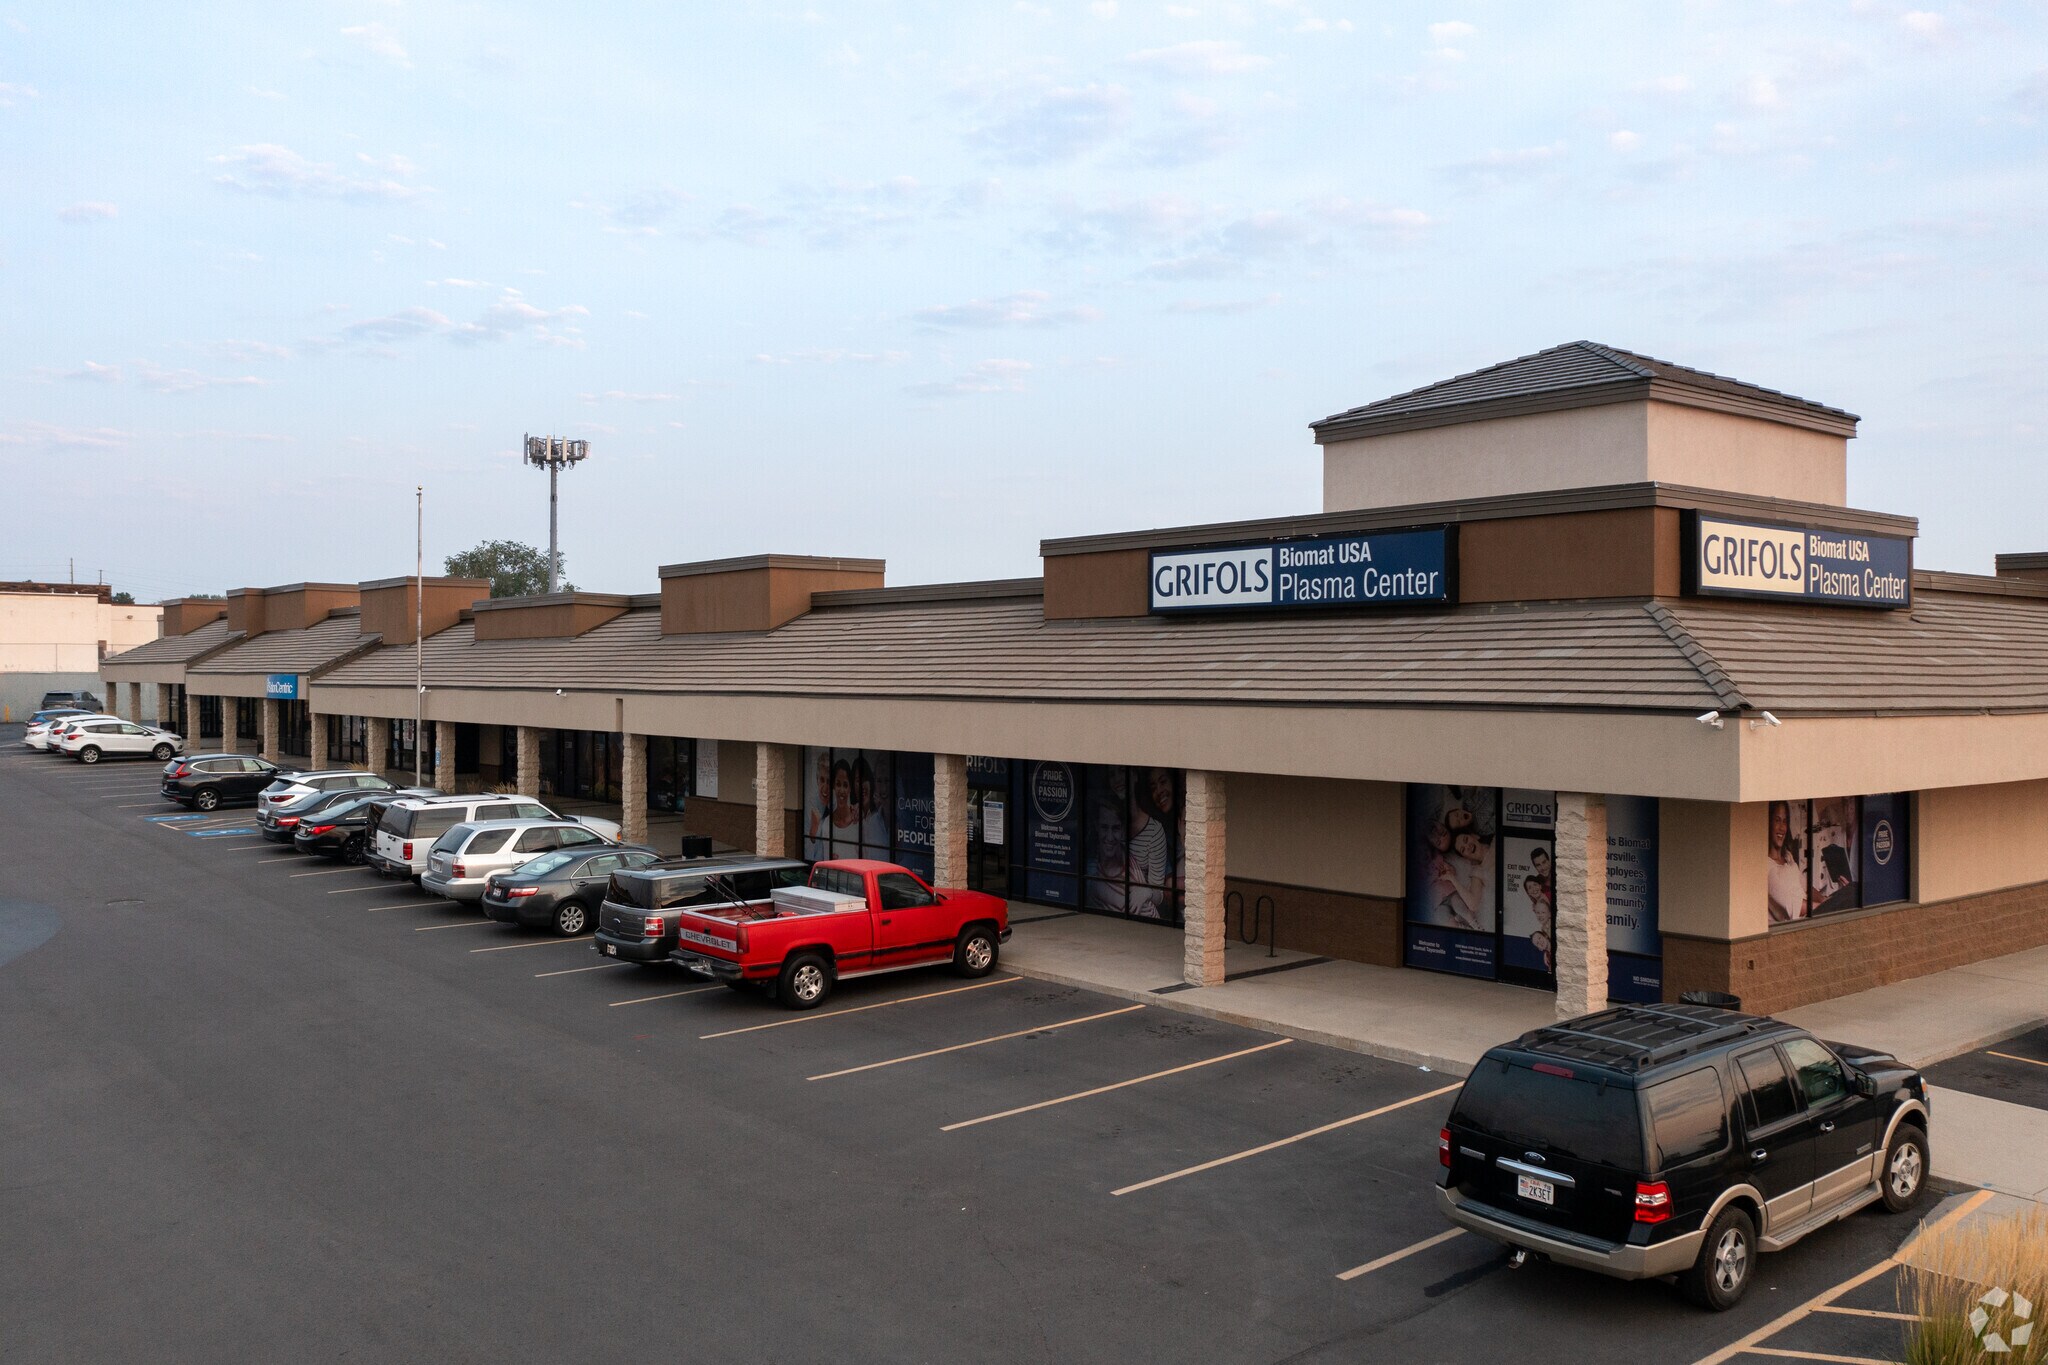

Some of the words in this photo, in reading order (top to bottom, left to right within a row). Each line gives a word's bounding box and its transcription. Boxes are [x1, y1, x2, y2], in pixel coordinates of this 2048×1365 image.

[1279, 544, 1335, 568] Biomat
[1338, 541, 1372, 564] USA
[1809, 535, 1847, 560] Biomat
[1849, 540, 1870, 562] USA
[1703, 533, 1802, 581] GRIFOLS
[1154, 558, 1269, 597] GRIFOLS
[1279, 572, 1356, 601] Plasma
[1363, 567, 1439, 598] Center
[1809, 563, 1860, 597] Plasma
[1864, 568, 1906, 600] Center
[1042, 769, 1063, 781] PRIDE
[1038, 786, 1068, 798] PASSION
[897, 797, 935, 813] CARING
[1506, 802, 1552, 815] GRIFOLS
[897, 829, 935, 847] PEOPLE
[1618, 836, 1650, 849] Biomat
[1507, 863, 1518, 871] EXIT
[1518, 864, 1530, 872] ONLY
[1629, 884, 1646, 893] and
[685, 931, 730, 948] CHEVROLET
[1529, 1185, 1551, 1200] 2K3ET
